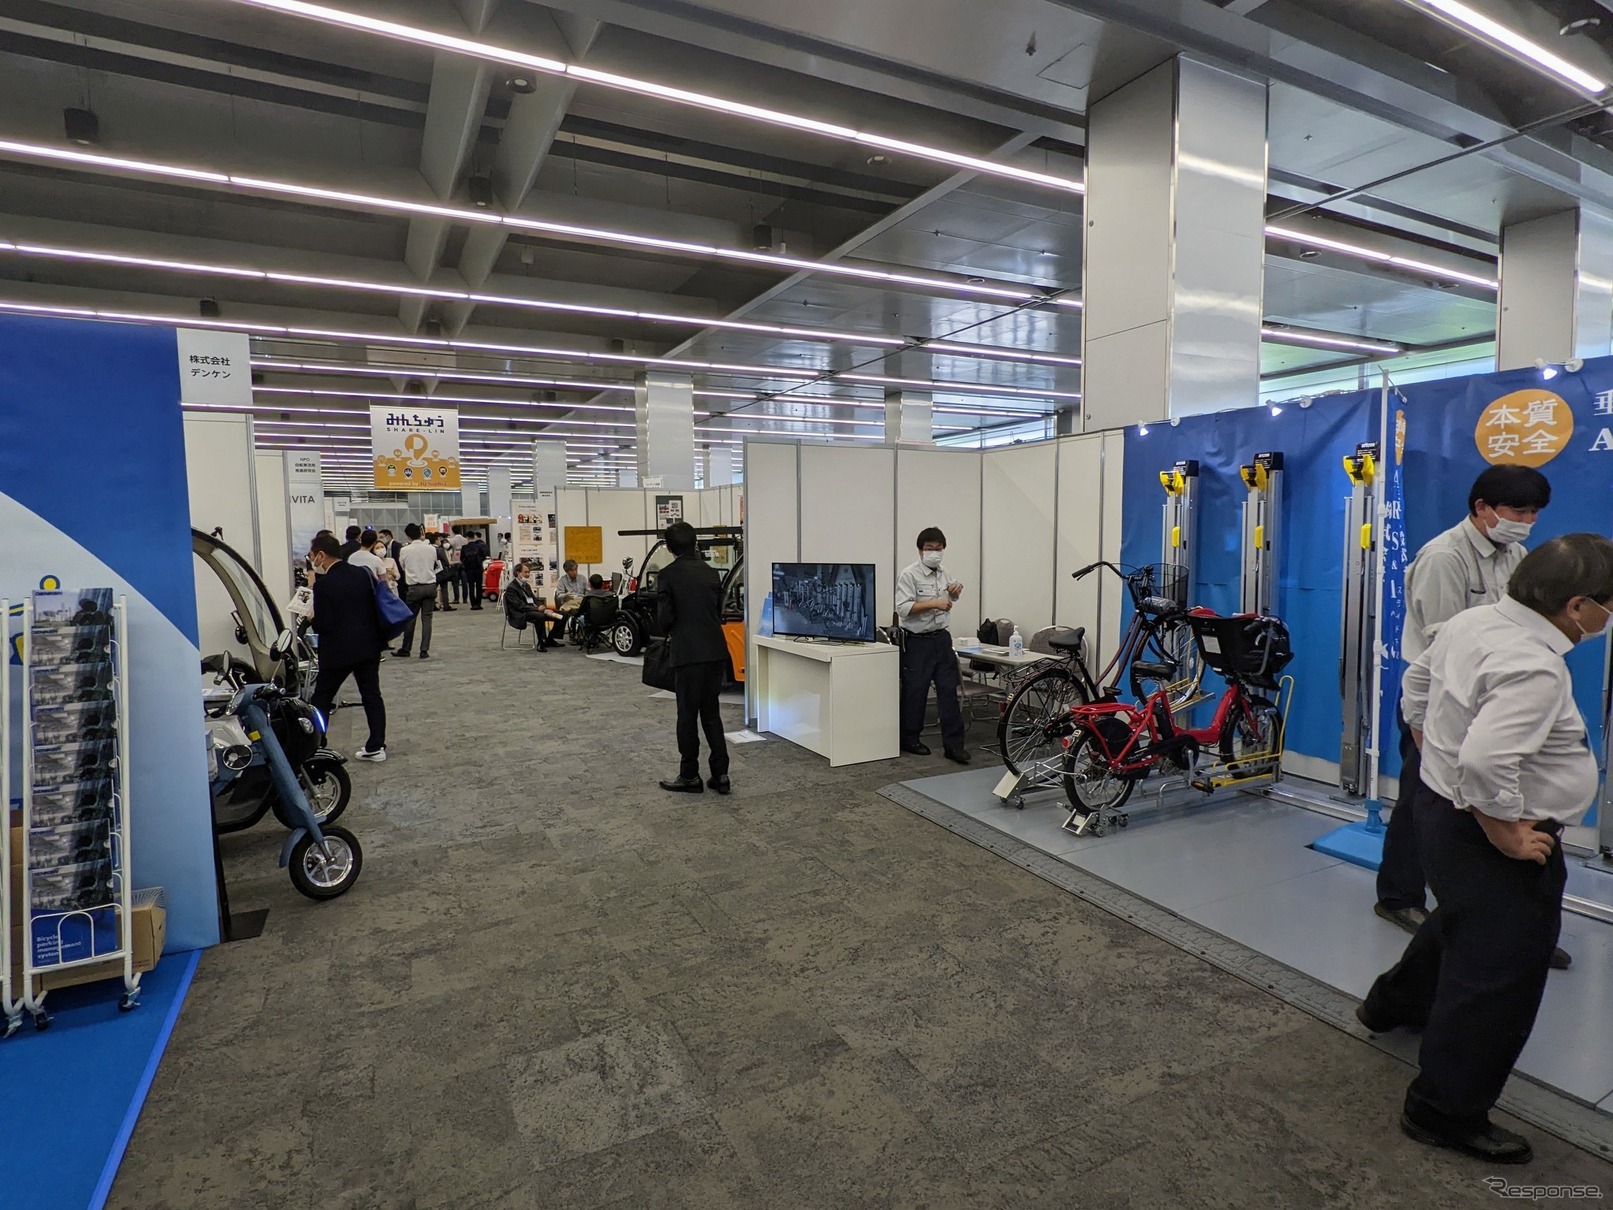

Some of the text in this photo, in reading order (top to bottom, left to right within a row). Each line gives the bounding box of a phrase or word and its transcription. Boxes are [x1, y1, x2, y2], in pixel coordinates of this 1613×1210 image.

[189, 355, 231, 366] 株式会社
[190, 368, 231, 379] デンケン
[1485, 398, 1558, 429] 本質
[1487, 429, 1560, 458] 安全
[291, 495, 316, 504] VITA
